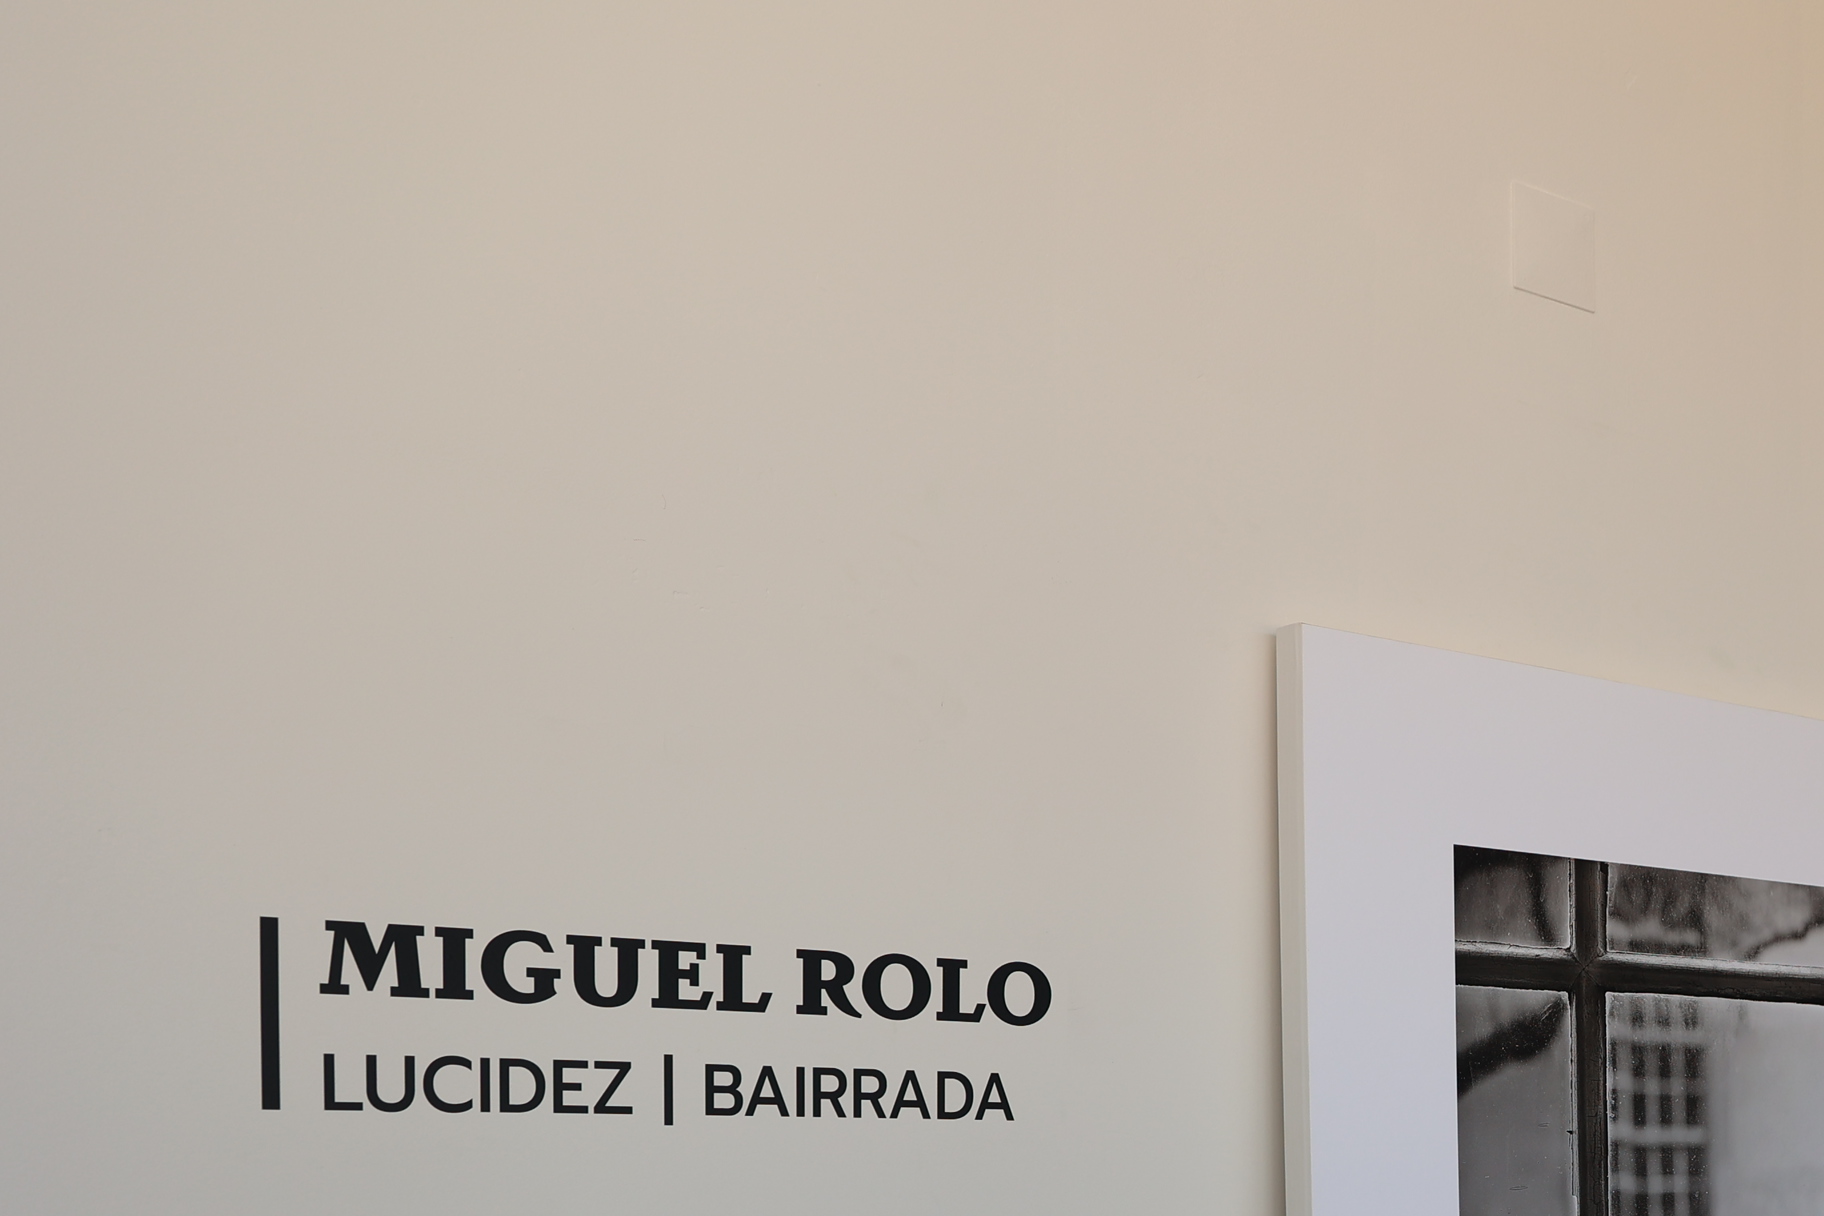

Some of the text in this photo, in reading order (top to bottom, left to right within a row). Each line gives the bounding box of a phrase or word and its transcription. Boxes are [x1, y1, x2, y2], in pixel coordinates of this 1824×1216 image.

[319, 919, 1052, 1027] MIGUEL ROLO
[323, 1053, 634, 1115] LUCIDEZ
[704, 1063, 1015, 1122] BAIRRADA
